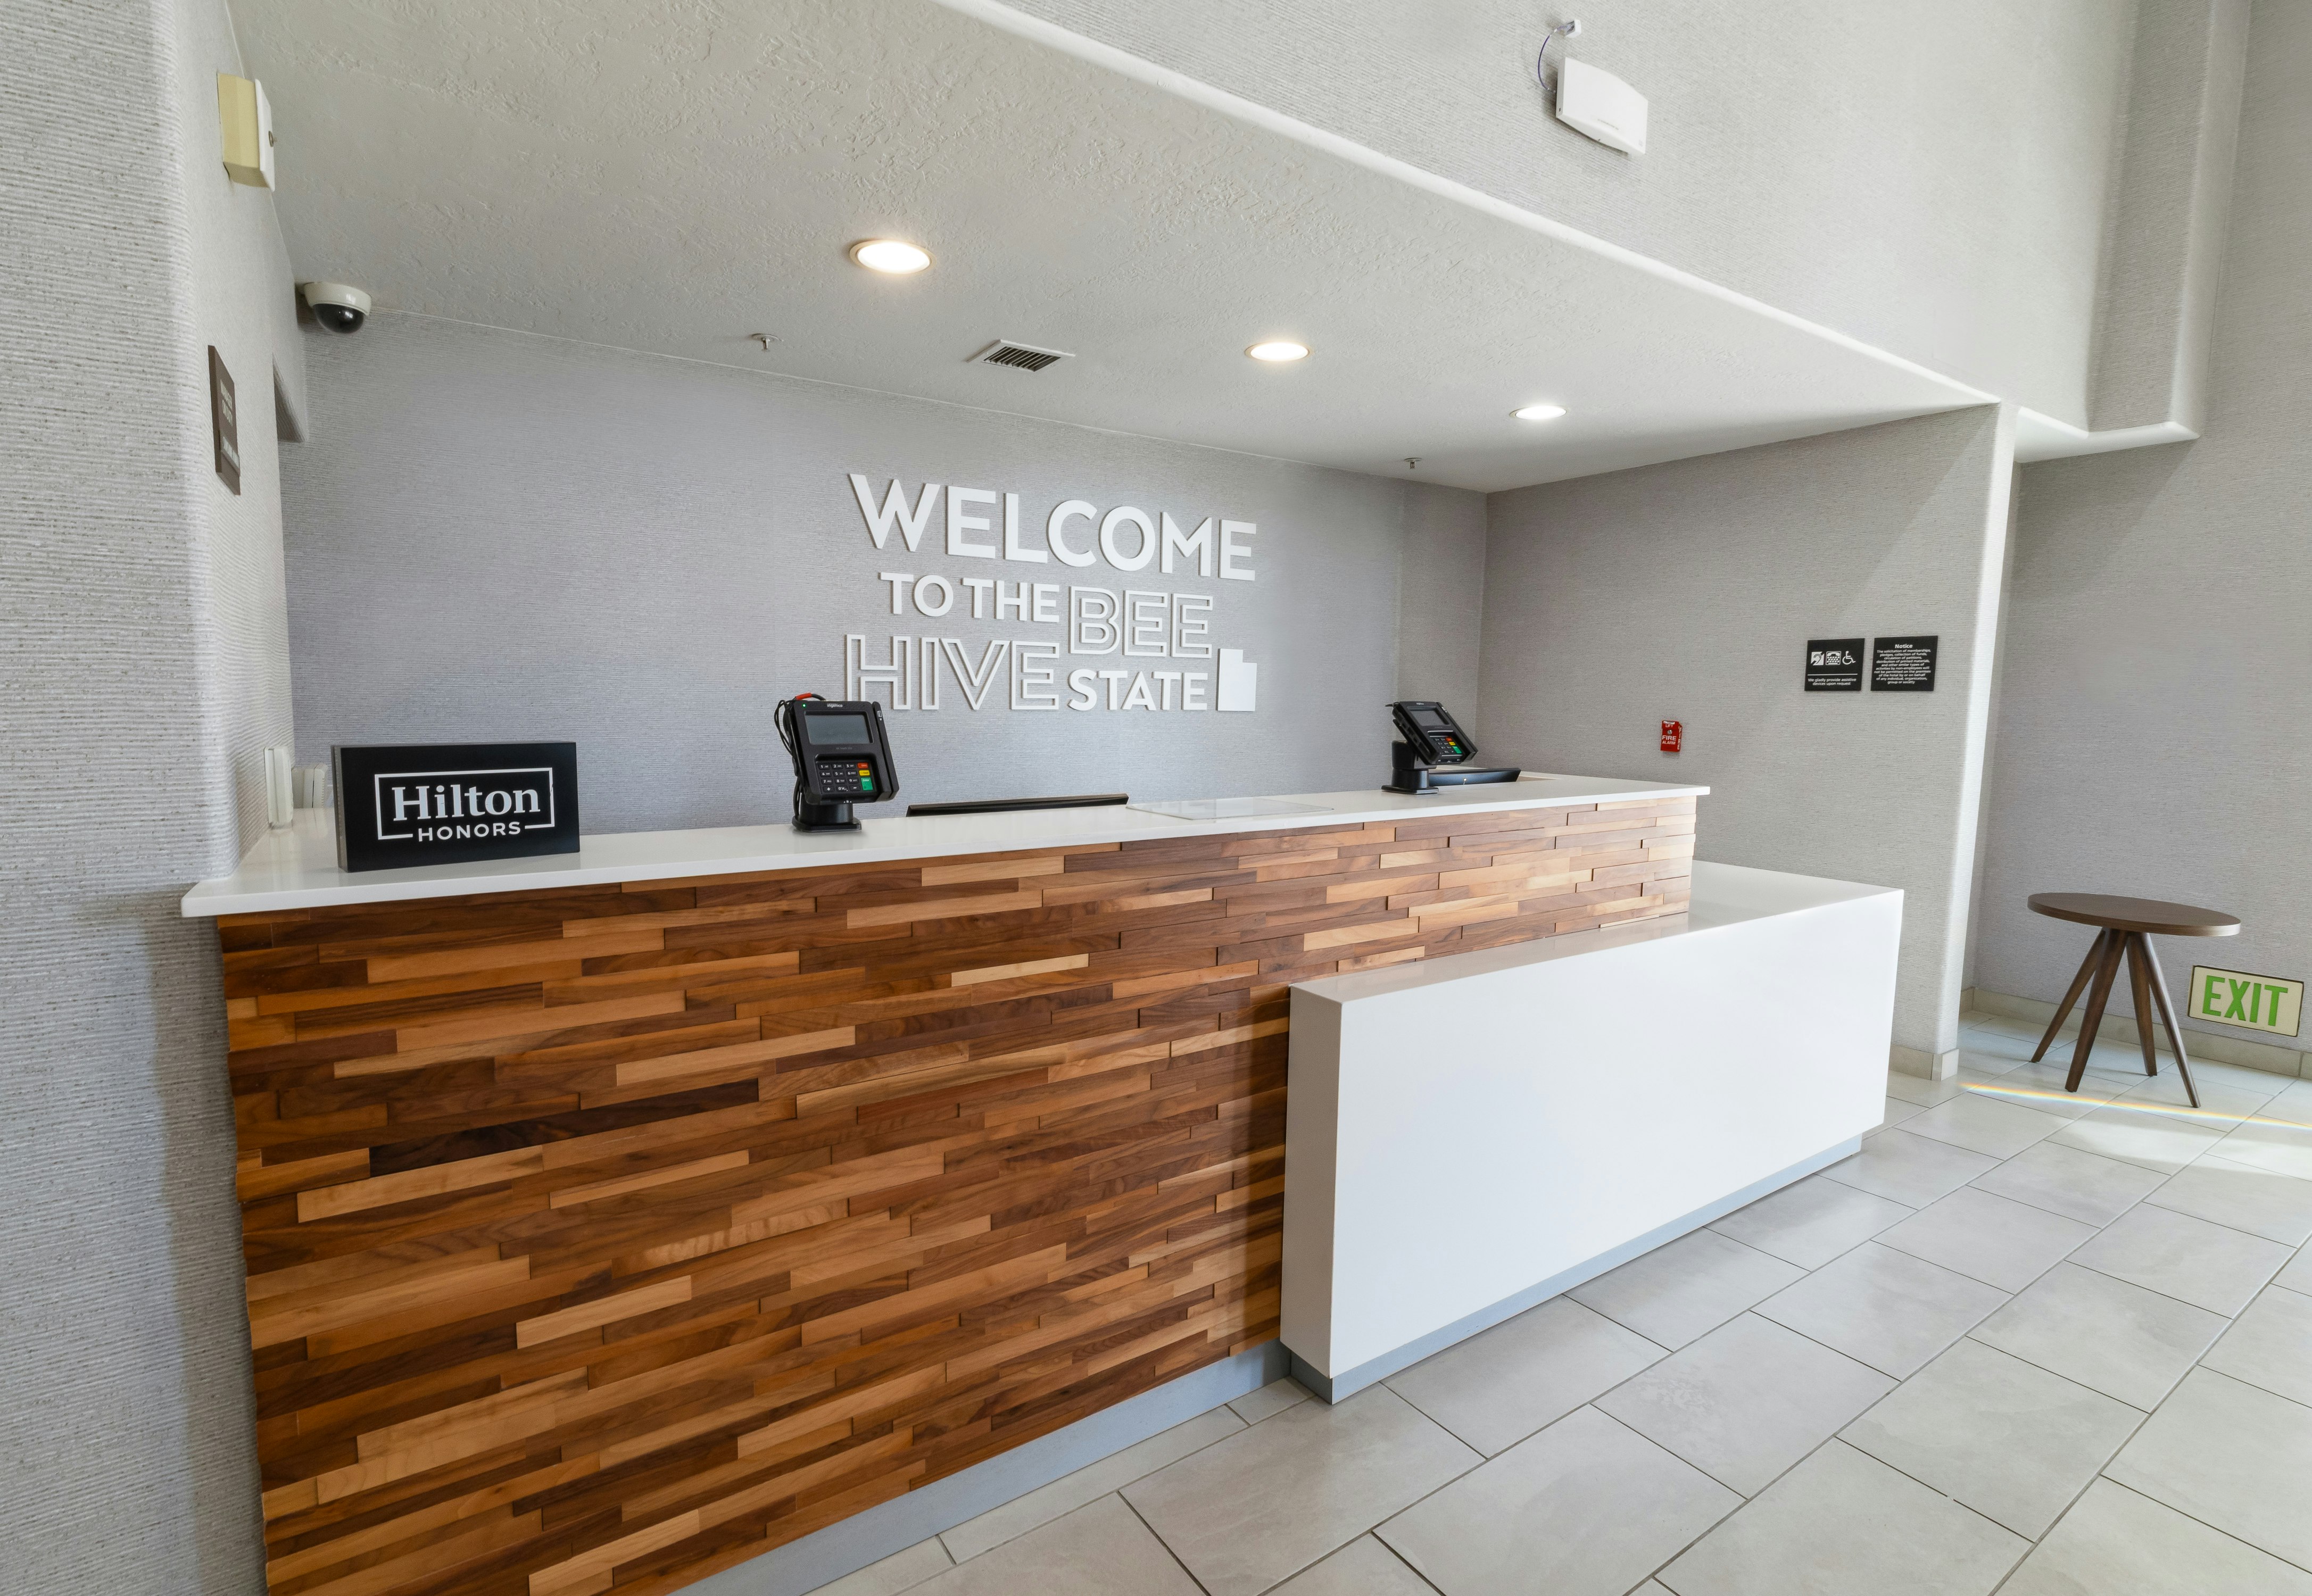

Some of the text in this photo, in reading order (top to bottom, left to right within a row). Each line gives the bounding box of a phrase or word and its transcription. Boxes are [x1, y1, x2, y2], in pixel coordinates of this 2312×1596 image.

[848, 472, 1257, 581] WELCOME
[880, 571, 1214, 659] TO THE BEE
[844, 634, 1209, 712] HIVE STATE
[392, 784, 541, 821] Hilton
[418, 821, 521, 842] HONORS
[2202, 975, 2288, 1026] EXIT
